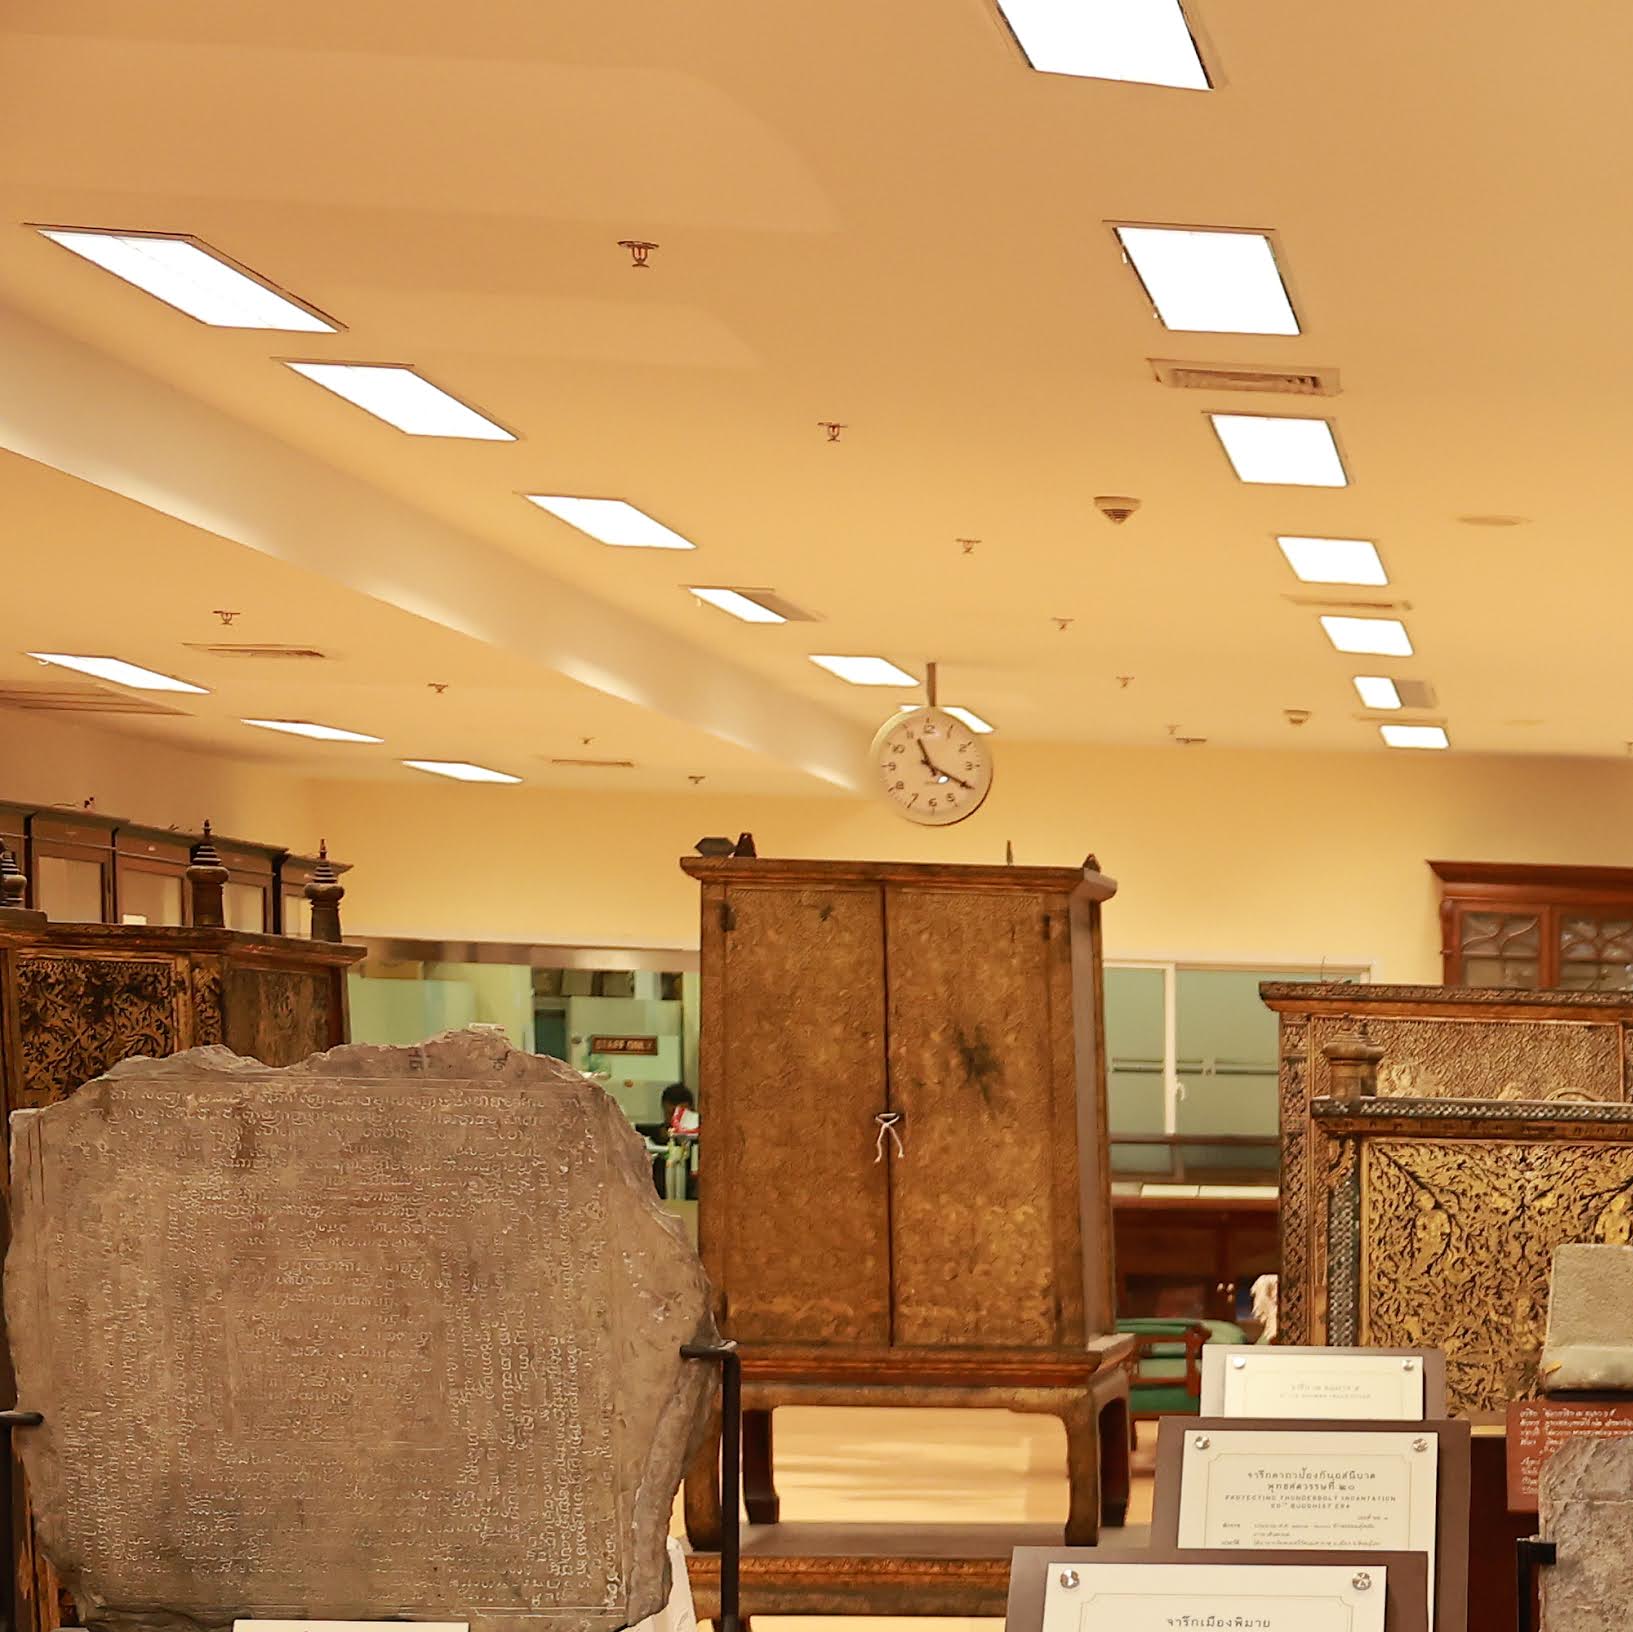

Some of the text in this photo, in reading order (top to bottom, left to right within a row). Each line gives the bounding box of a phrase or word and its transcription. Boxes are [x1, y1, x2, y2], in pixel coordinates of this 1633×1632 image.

[1166, 1615, 1271, 1628] จารึกเมืองพิมาย
